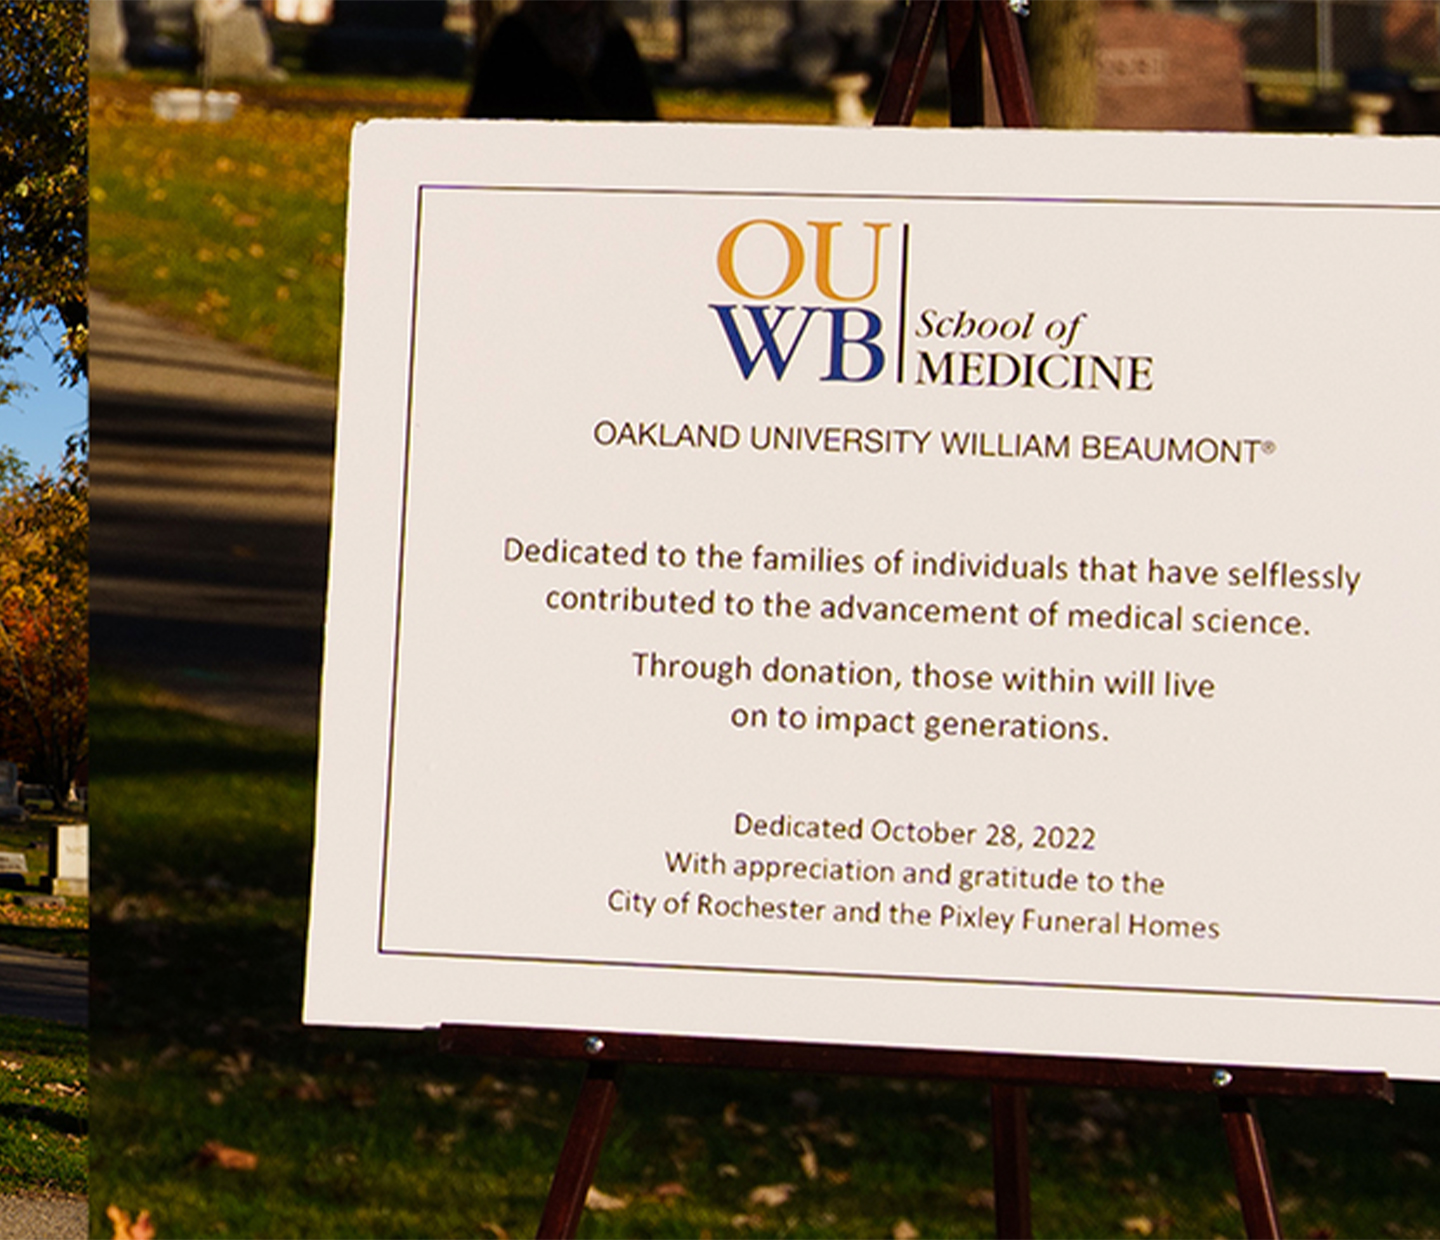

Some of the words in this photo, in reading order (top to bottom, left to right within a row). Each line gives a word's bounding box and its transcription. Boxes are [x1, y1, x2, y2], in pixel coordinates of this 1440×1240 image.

[715, 217, 892, 303] OU
[708, 303, 887, 384] WB
[914, 308, 1034, 341] School
[1044, 310, 1088, 347] of
[914, 350, 1155, 392] MEDICINE
[593, 420, 741, 449] OAKLAND
[750, 425, 932, 455] UNIVERSITY
[940, 431, 1071, 459] WILLIAM
[504, 537, 648, 567] Dedicated
[657, 544, 687, 568] to
[696, 542, 744, 570] the
[752, 544, 865, 574] families
[874, 548, 905, 575] of
[912, 550, 1069, 581] individuals
[1078, 555, 1138, 583] that
[1148, 557, 1219, 586] have
[1228, 561, 1361, 596] selflessly
[546, 586, 716, 615] contributed
[724, 593, 754, 617] to
[763, 591, 812, 619] the
[820, 594, 1019, 626] advancement
[1028, 600, 1060, 627] of
[1068, 603, 1183, 632] medical
[1192, 608, 1310, 636] science.
[632, 651, 752, 687] Through
[762, 656, 902, 691] donation,
[912, 662, 994, 691] those
[1002, 666, 1095, 694] within
[1104, 669, 1155, 696] will
[1164, 670, 1216, 699] live
[730, 708, 768, 728] on
[777, 706, 808, 730] to
[816, 705, 916, 738] impact
[924, 714, 1109, 742] generations.
[734, 812, 864, 841] Dedicated
[871, 818, 978, 845] October
[985, 823, 1024, 851] 28,
[1032, 825, 1096, 851] 2022
[665, 851, 727, 875] With
[733, 858, 895, 883] appreciation
[902, 862, 952, 885] and
[958, 867, 1079, 893] gratitude
[1087, 872, 1114, 893] to
[1121, 871, 1165, 896] the
[608, 889, 657, 918] City
[663, 891, 691, 915] of
[697, 893, 826, 921] Rochester
[833, 901, 882, 924] and
[889, 902, 932, 927] the
[940, 904, 1015, 935] Pixley
[1022, 908, 1120, 935] Funeral
[1128, 913, 1220, 939] Homes
